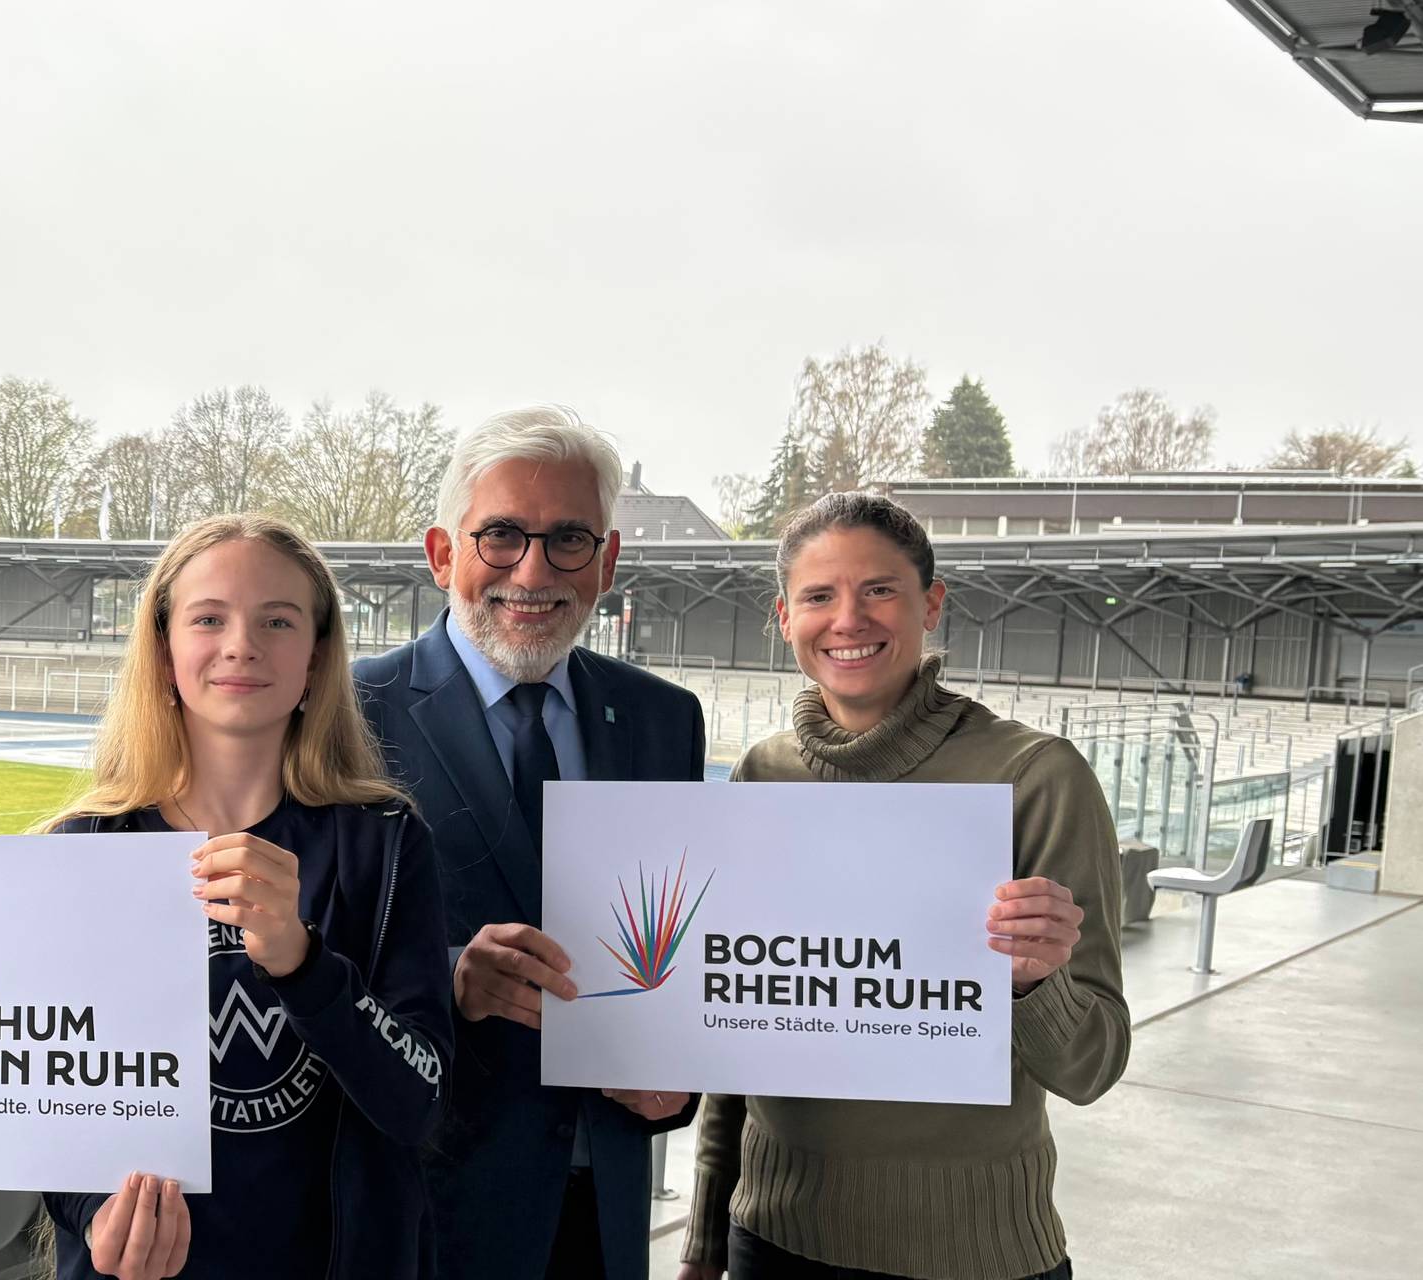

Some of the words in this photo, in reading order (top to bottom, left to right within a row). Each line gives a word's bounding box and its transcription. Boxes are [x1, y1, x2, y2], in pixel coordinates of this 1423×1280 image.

[704, 933, 902, 970] BOCHUM
[704, 972, 838, 1008] RHEIN
[854, 977, 983, 1012] RUHR
[703, 1013, 769, 1031] Unsere
[774, 1016, 839, 1033] Städte.
[845, 1019, 912, 1035] Unsere
[918, 1021, 982, 1040] Spiele.
[46, 1050, 180, 1088] RUHR
[38, 1098, 107, 1116] Unsere
[112, 1100, 179, 1121] Spiele.
